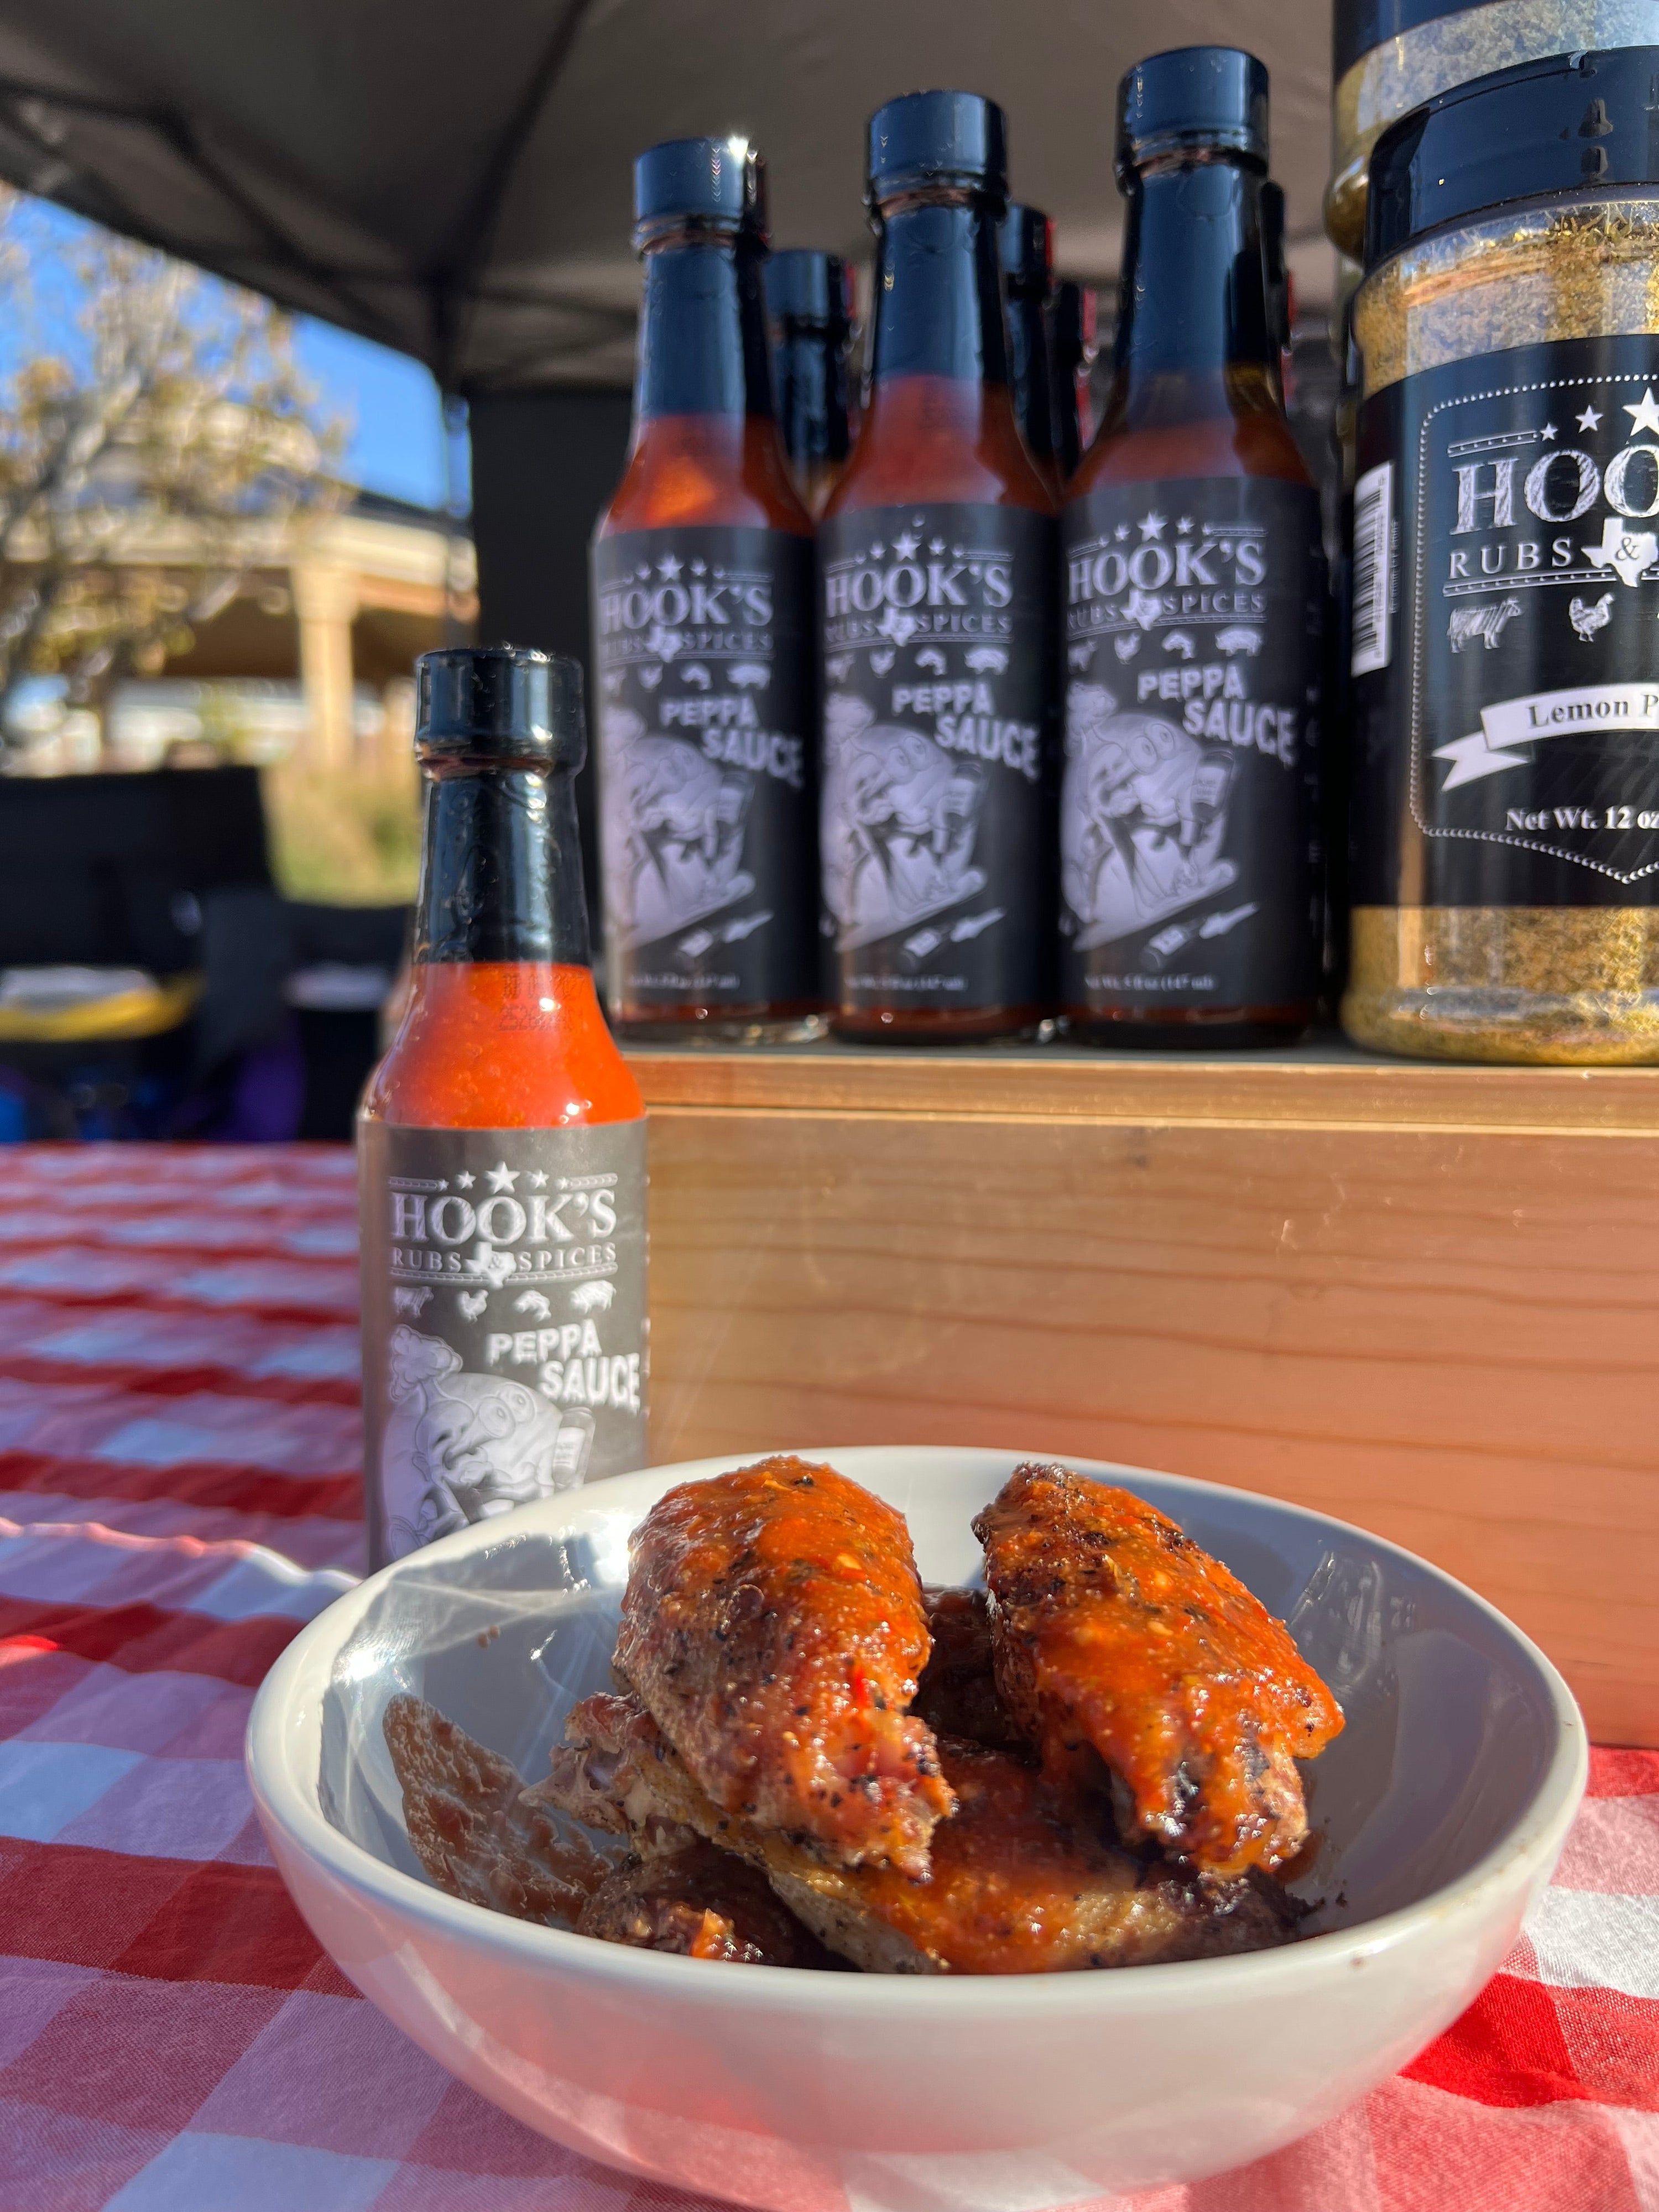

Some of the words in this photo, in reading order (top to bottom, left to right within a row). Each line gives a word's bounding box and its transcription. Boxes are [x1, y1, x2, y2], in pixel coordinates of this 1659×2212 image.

[1449, 445, 1659, 534] HOO
[1069, 539, 1266, 604] HOOK'S
[1449, 538, 1574, 580] RUBS
[1615, 537, 1640, 561] &
[601, 583, 773, 635] HOOK'S
[825, 563, 1013, 617] HOOK'S
[1162, 587, 1266, 615] SPICES
[916, 613, 1013, 634] SPICES
[891, 682, 993, 716] PEPPA
[1138, 663, 1246, 702] PEPPA
[661, 695, 760, 728] PEPPA
[1182, 698, 1297, 769] SAUCE
[1528, 700, 1629, 728] Lemon
[701, 727, 804, 789] SAUCE
[934, 714, 1039, 780] SAUCE
[1505, 807, 1548, 831] Net
[1553, 806, 1598, 830] Wt.
[1605, 805, 1634, 830] 12
[392, 1188, 617, 1245] HOOK'S
[392, 1246, 461, 1272] RUBS
[517, 1242, 617, 1272] SPICES
[486, 1319, 602, 1365] PEPPA
[538, 1353, 640, 1416] SAUCE
